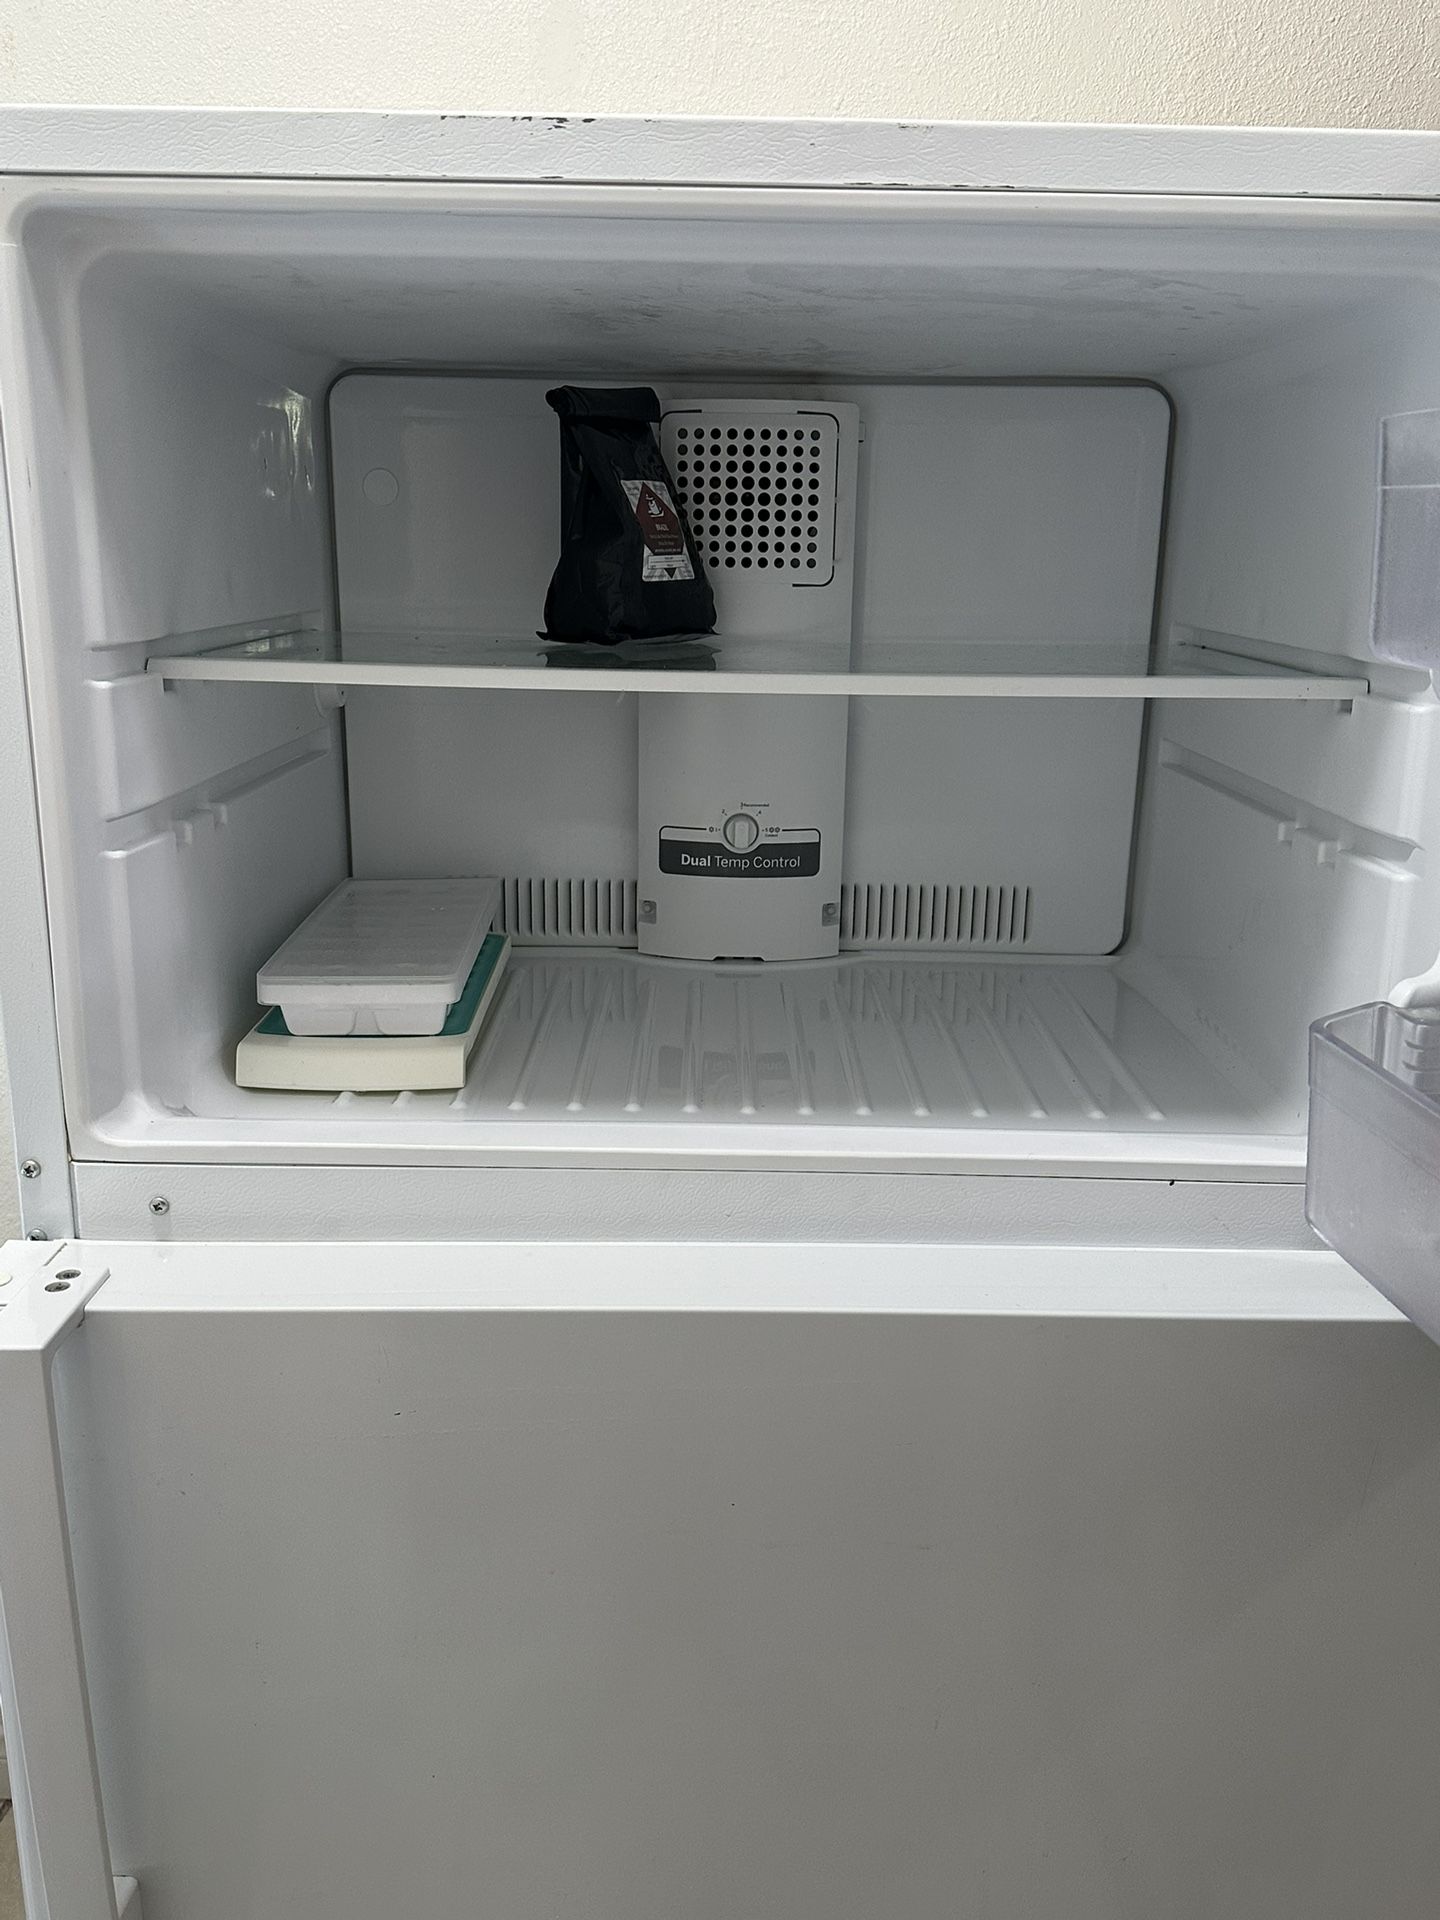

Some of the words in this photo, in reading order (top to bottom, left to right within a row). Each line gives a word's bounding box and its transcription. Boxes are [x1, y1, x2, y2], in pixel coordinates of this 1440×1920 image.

[681, 853, 711, 867] Dual
[715, 856, 750, 870] Temp
[752, 856, 801, 868] Control
